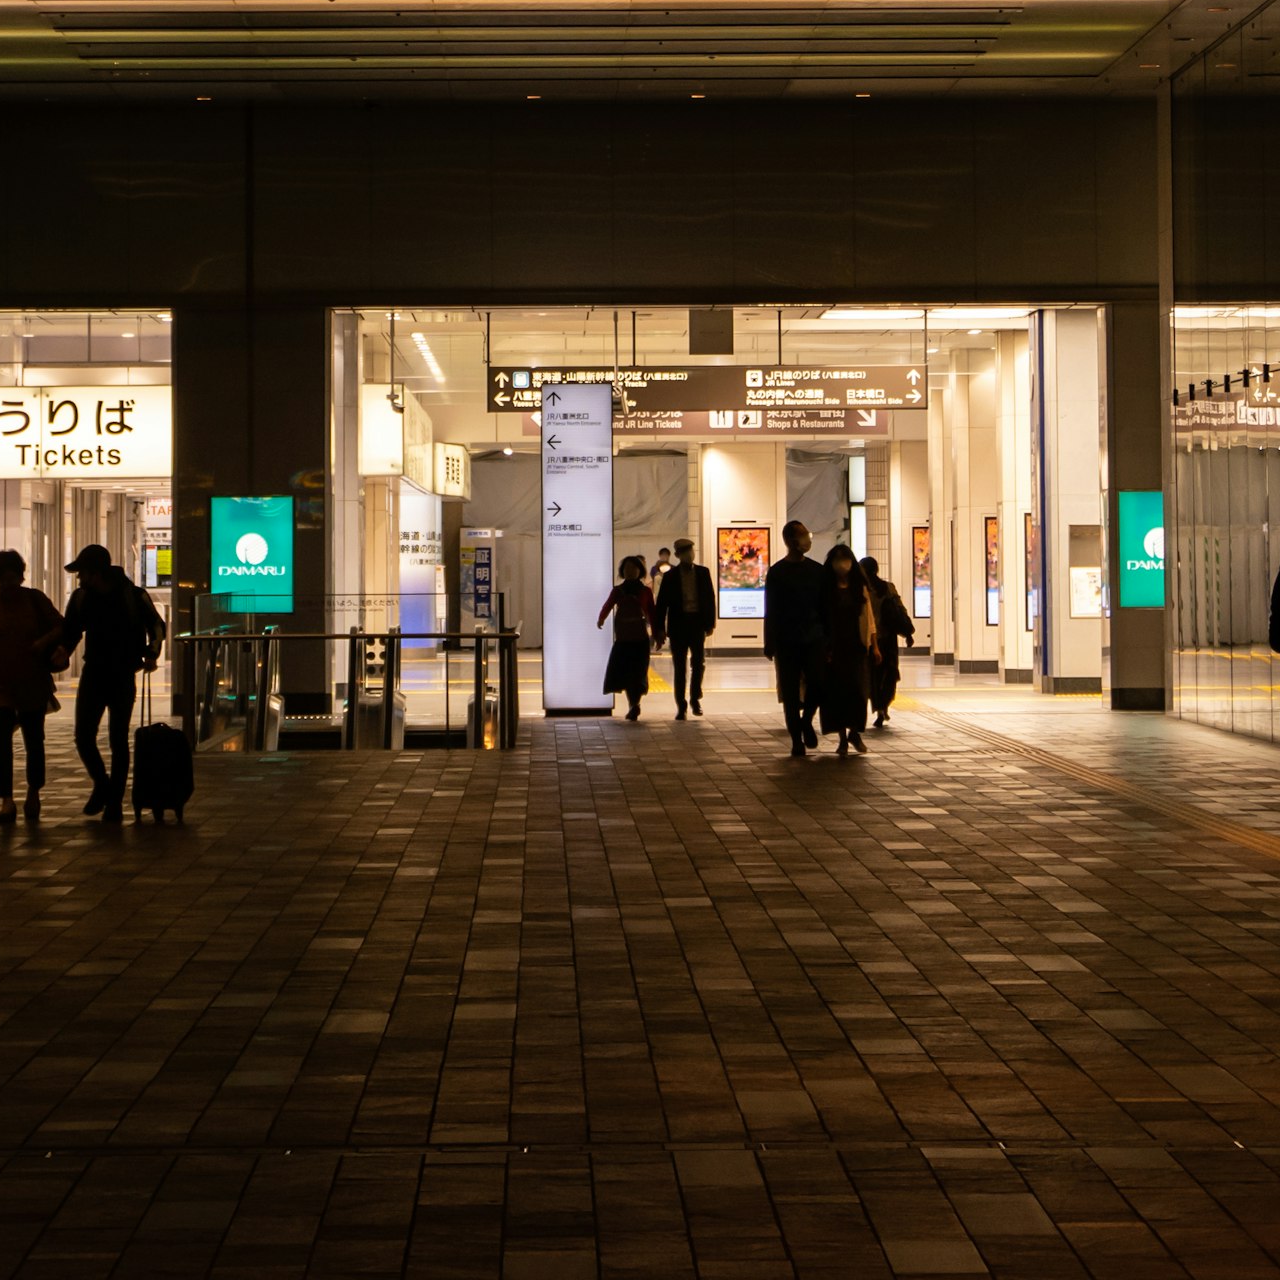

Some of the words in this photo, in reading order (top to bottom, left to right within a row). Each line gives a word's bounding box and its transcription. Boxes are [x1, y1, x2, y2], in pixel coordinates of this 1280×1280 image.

[765, 370, 820, 380] JR線のりば
[846, 389, 885, 399] 日本橋口
[625, 420, 636, 429] JR
[637, 420, 654, 429] Line
[655, 420, 682, 429] Tickets
[767, 420, 791, 430] Shops
[792, 420, 798, 428] &
[800, 420, 845, 428] Restaurants
[15, 444, 122, 467] Tickets
[1126, 560, 1165, 570] DAIM
[218, 565, 286, 576] DAIMARU
